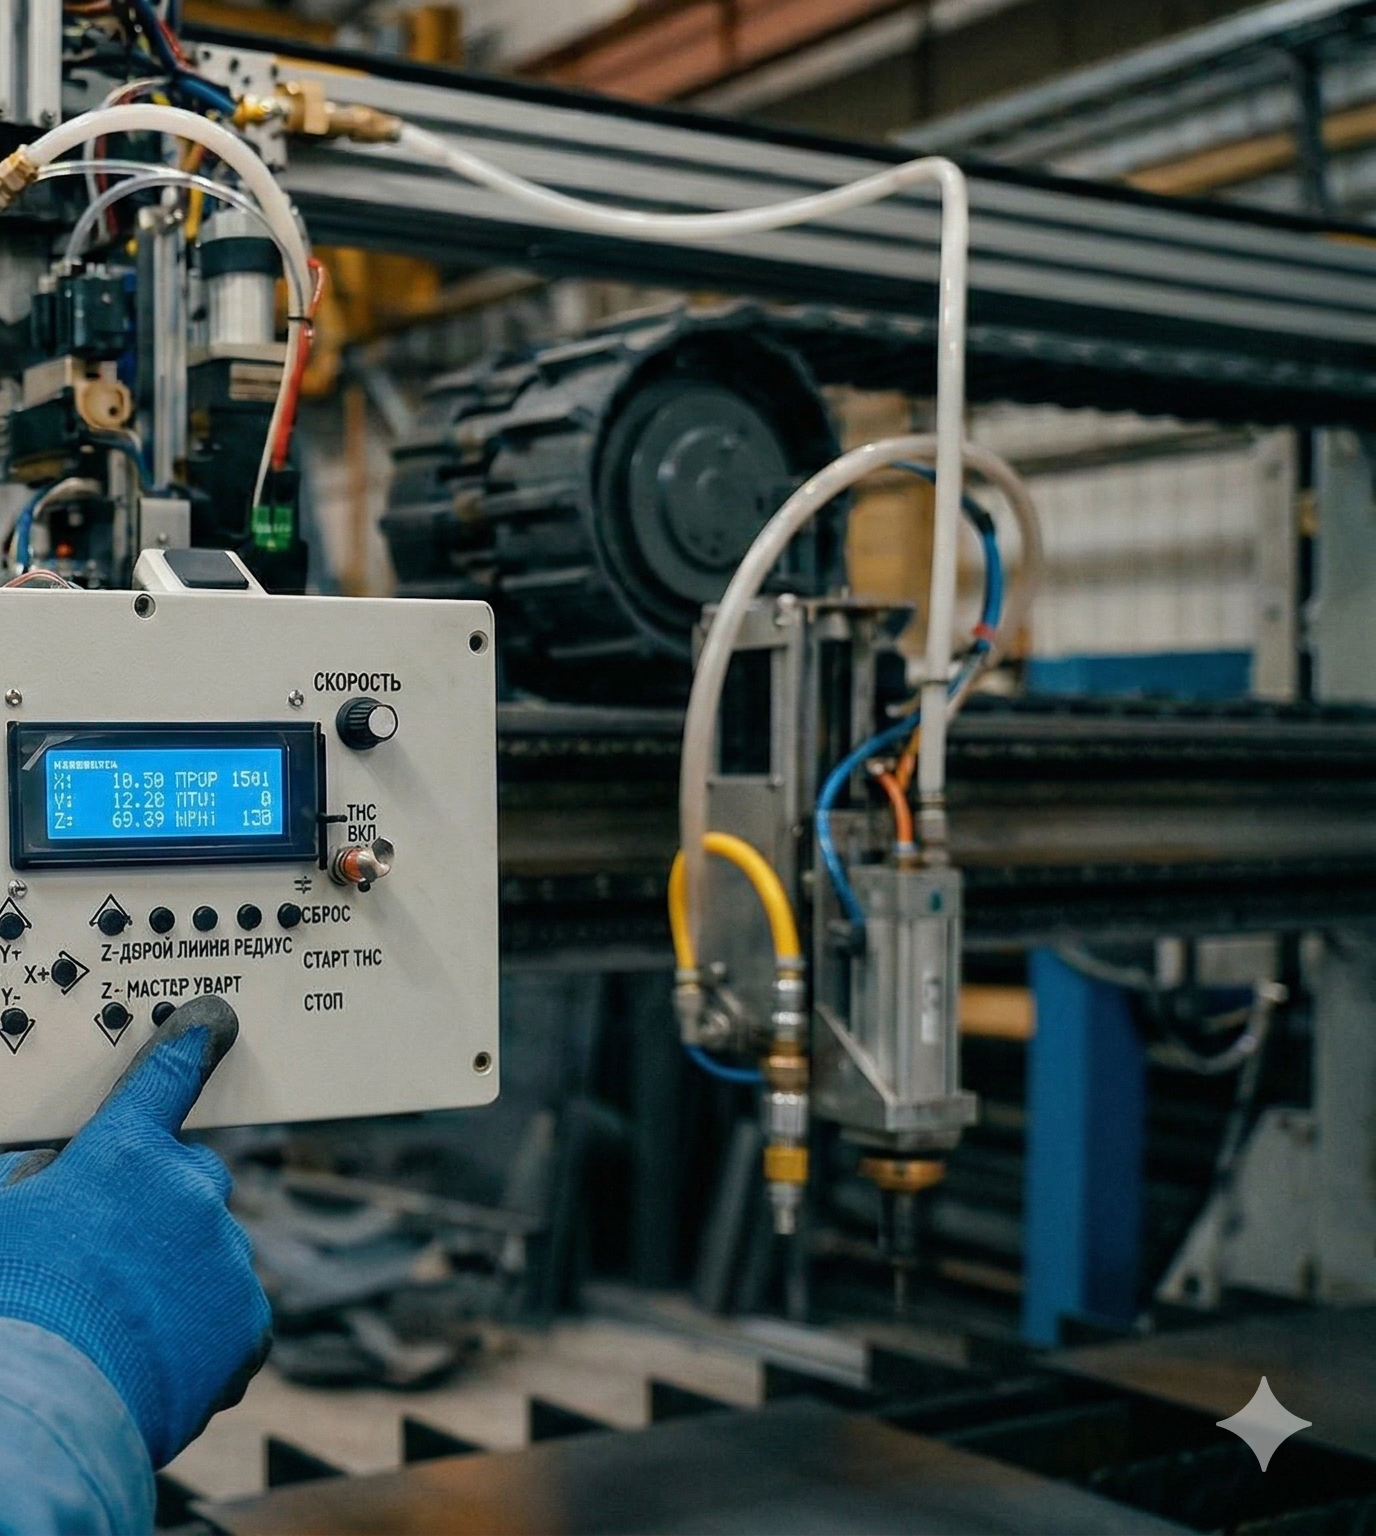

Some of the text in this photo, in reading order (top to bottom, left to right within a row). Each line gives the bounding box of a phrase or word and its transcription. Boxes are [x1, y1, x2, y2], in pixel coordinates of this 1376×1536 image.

[314, 672, 402, 692] СКОРОСТЬ
[114, 791, 165, 808] 12.20
[112, 811, 165, 828] 69.39
[347, 804, 377, 821] ТНС
[348, 824, 377, 842] ВКЛ
[301, 905, 351, 923] СБРОС
[304, 949, 382, 968] СТАРТ ТНС
[24, 965, 50, 984] X+
[304, 992, 343, 1011] СТОП
